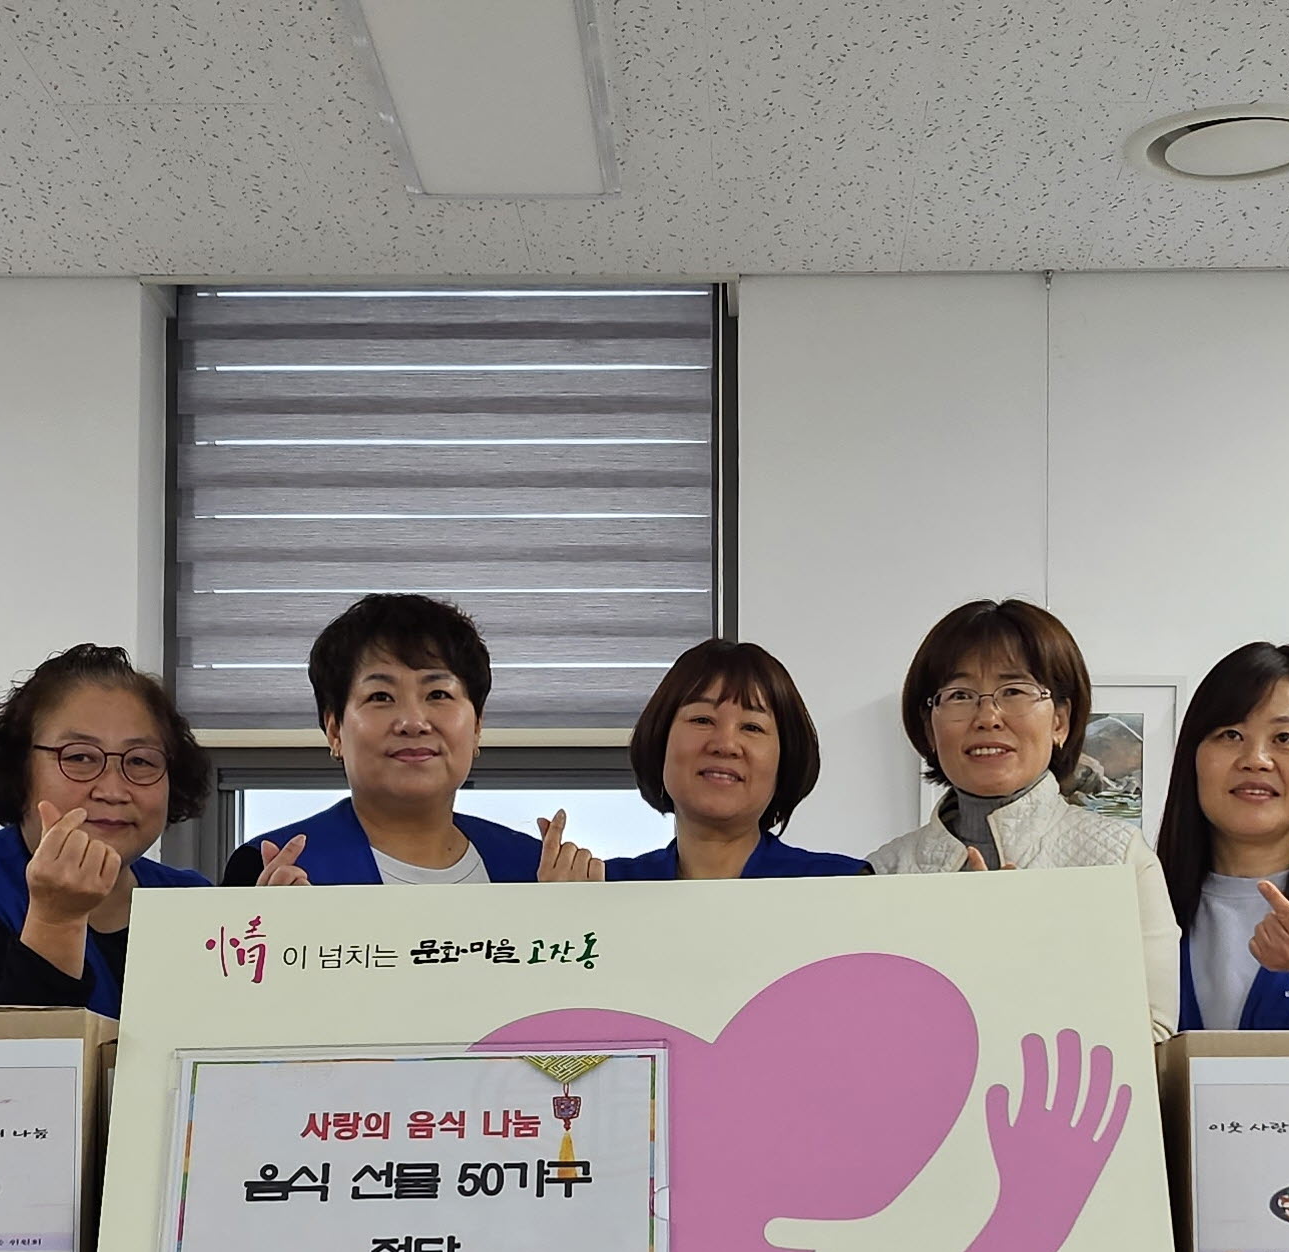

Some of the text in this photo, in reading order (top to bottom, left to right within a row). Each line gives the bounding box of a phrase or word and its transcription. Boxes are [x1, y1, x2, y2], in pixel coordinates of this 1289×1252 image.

[205, 915, 266, 984] 情
[319, 944, 399, 969] 넘치는
[526, 932, 600, 970] 고잔동
[13, 1128, 48, 1139] 나눔
[300, 1110, 541, 1140] 사랑의 음식 나눔
[244, 1160, 593, 1202] 음식 선물 50가구
